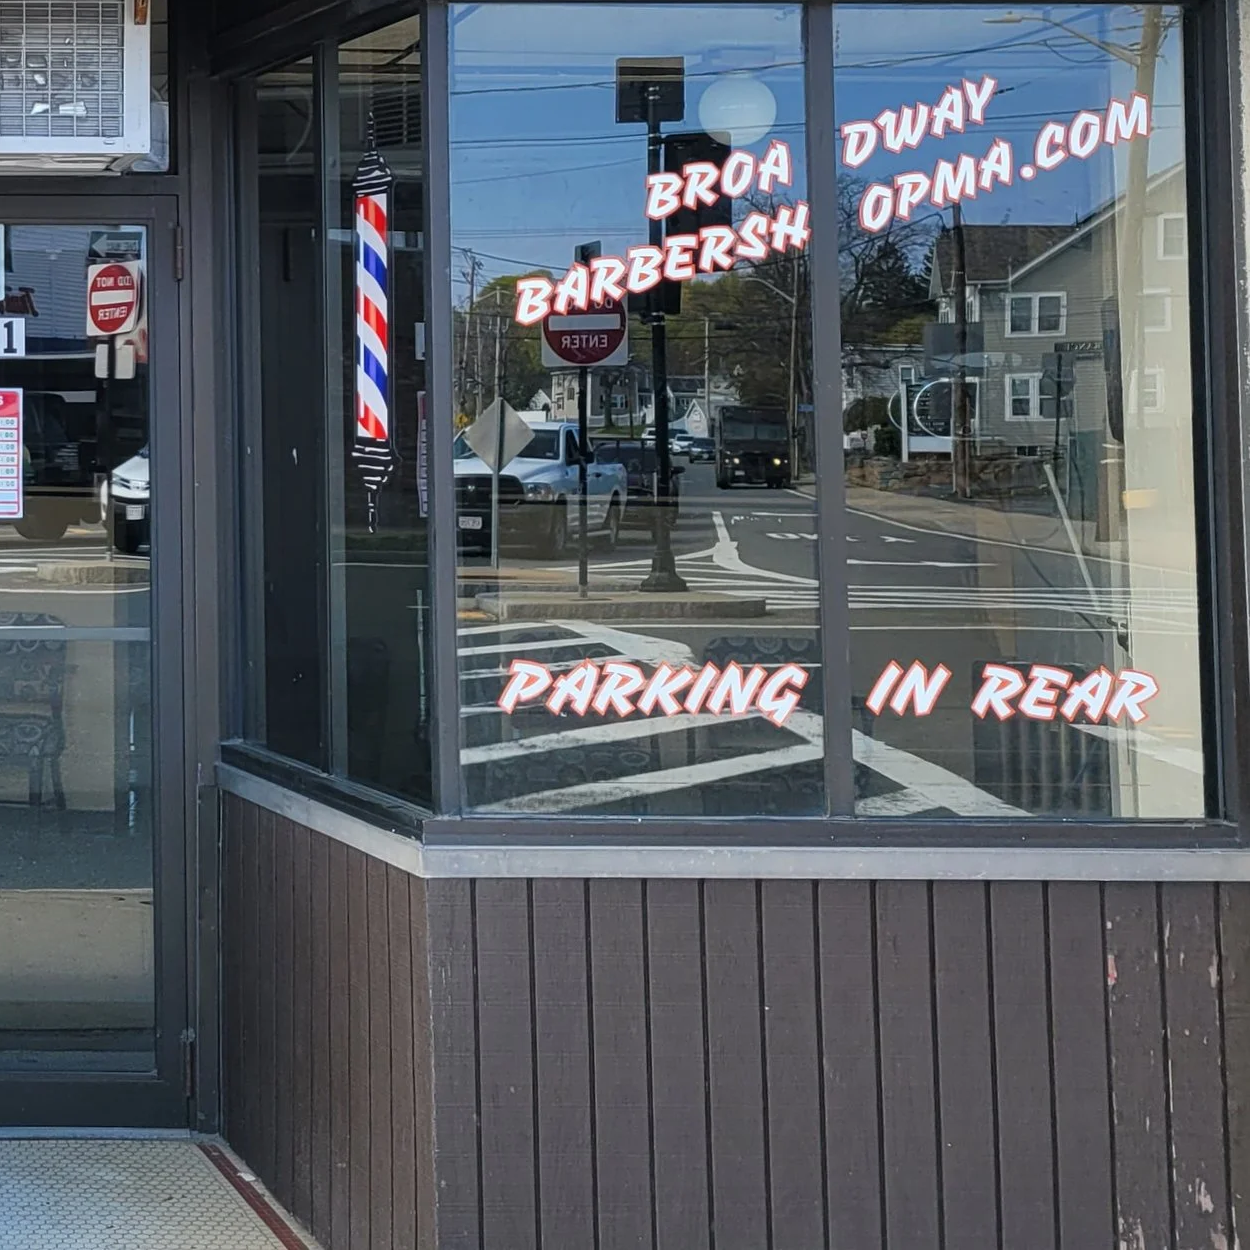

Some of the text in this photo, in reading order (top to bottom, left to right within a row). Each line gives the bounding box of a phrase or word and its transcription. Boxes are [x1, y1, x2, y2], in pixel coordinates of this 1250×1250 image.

[497, 659, 1160, 727] PARKING IN REAR
